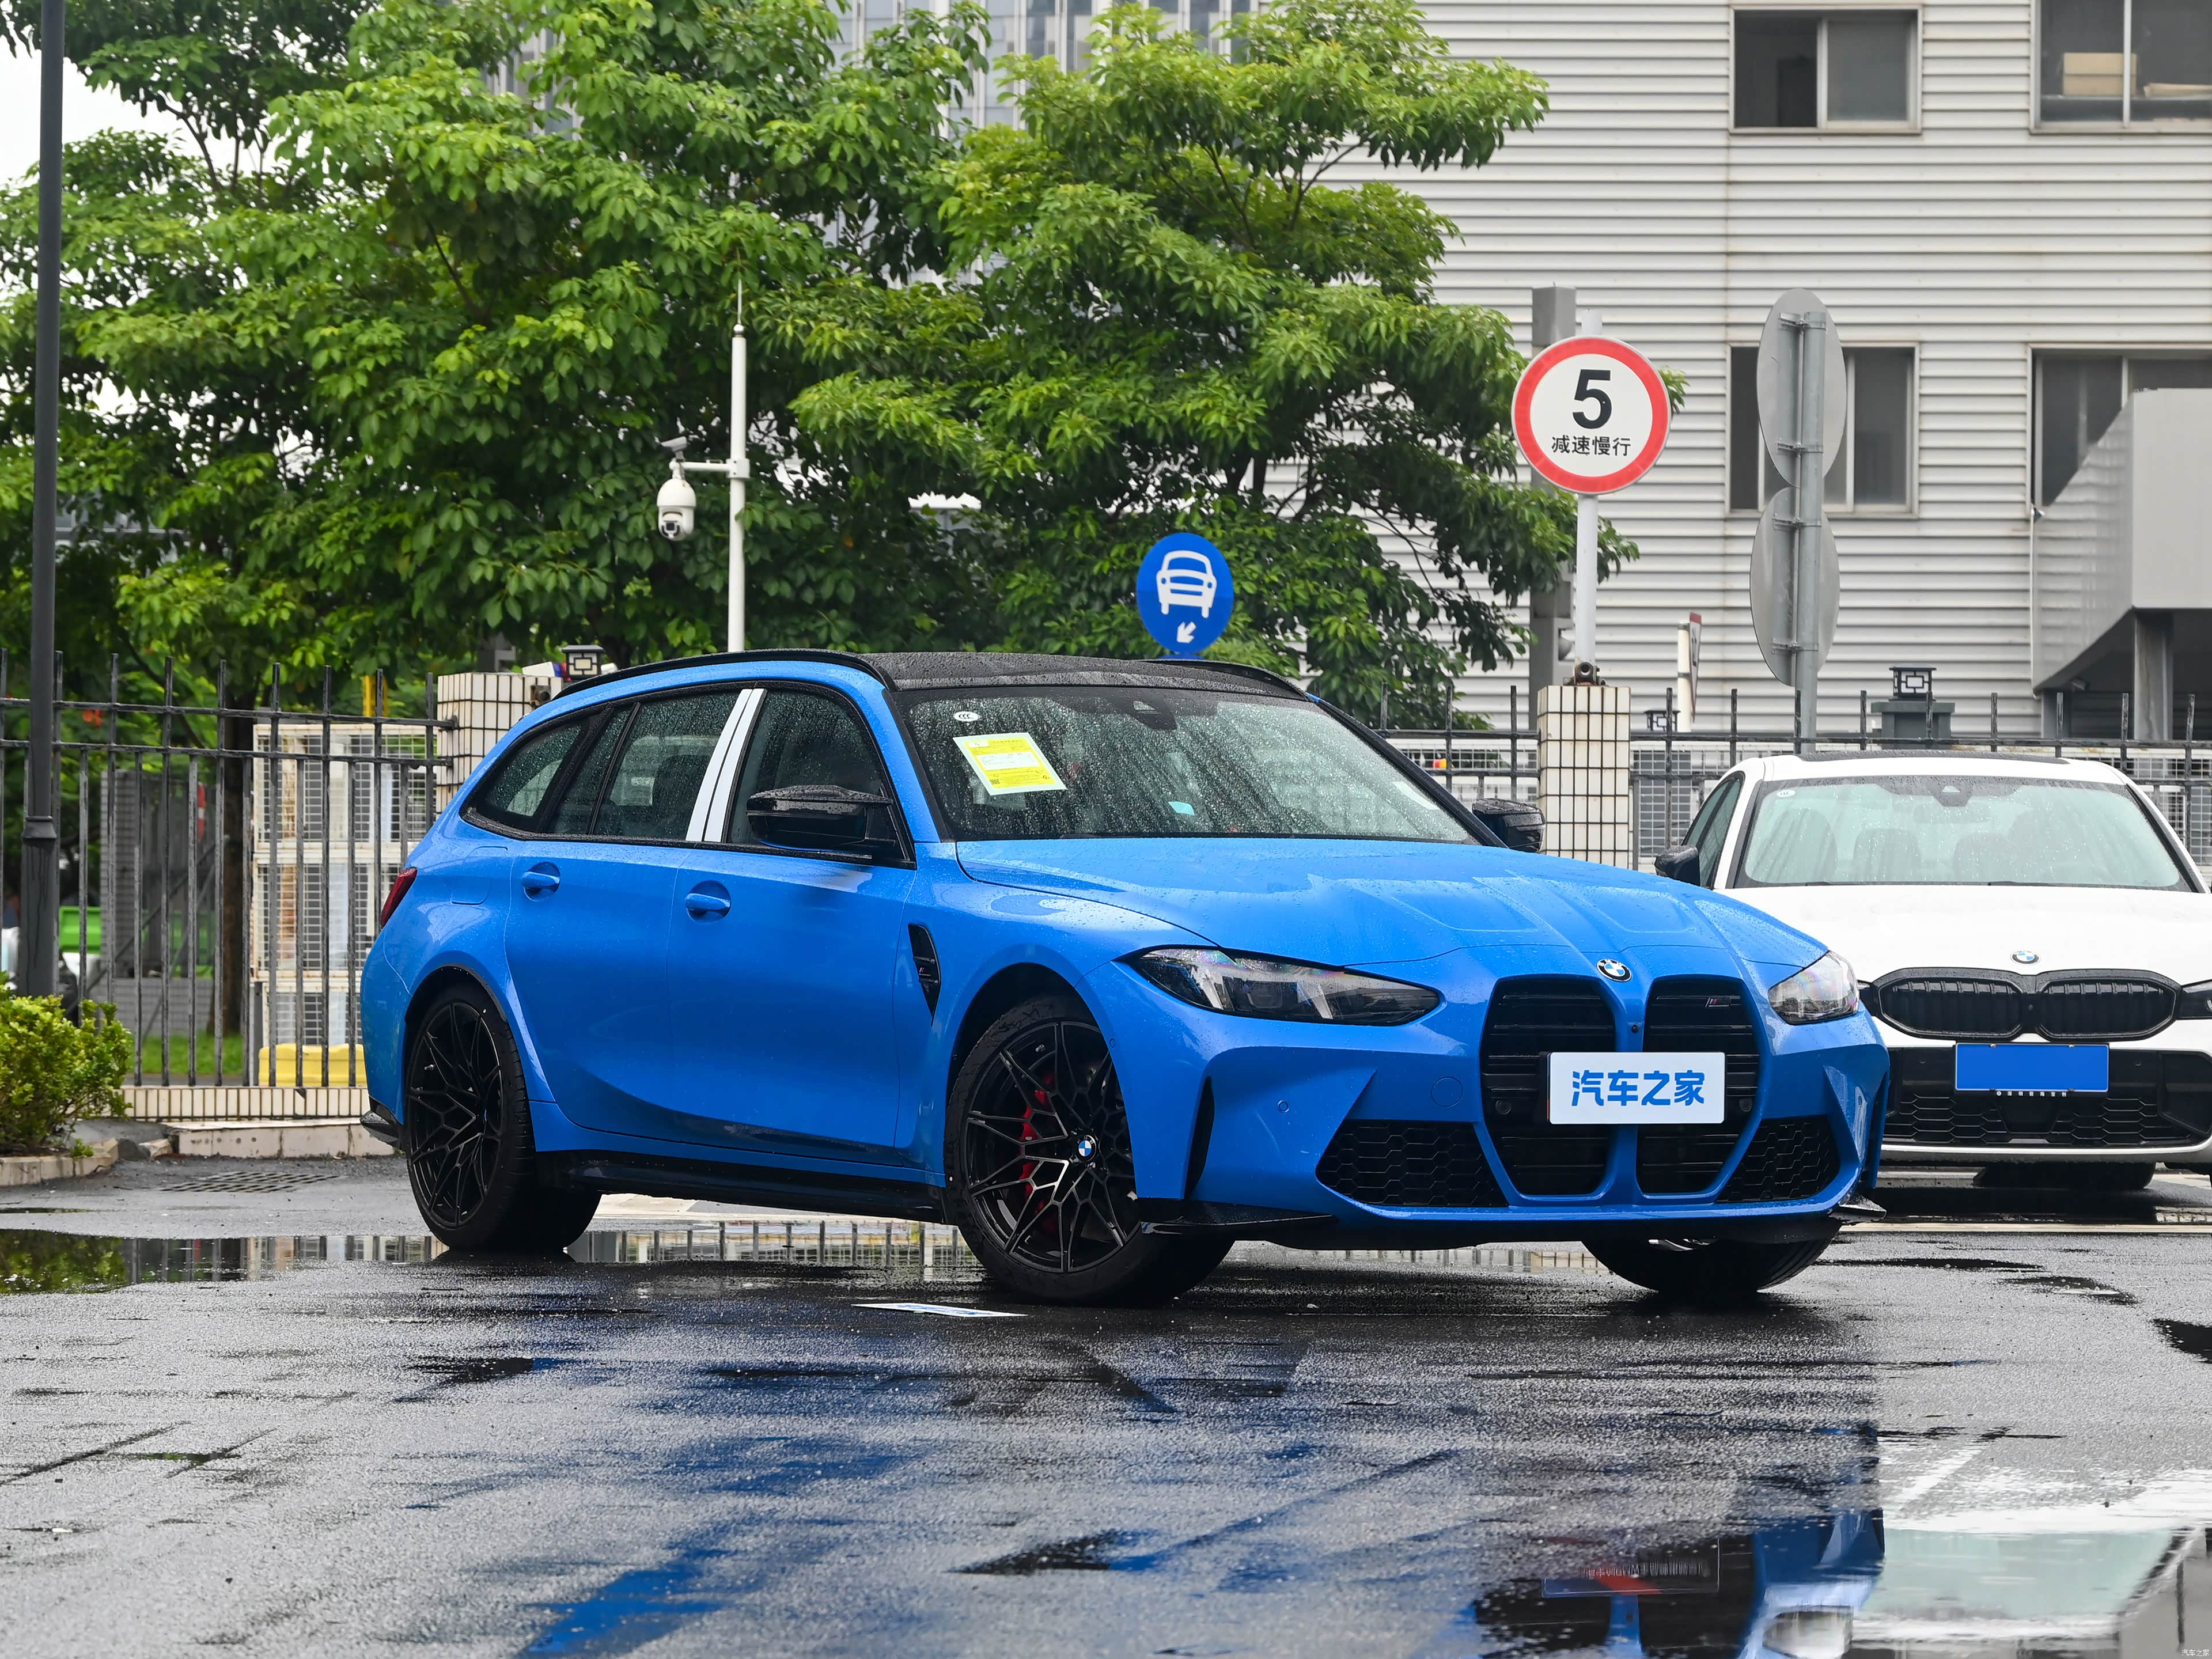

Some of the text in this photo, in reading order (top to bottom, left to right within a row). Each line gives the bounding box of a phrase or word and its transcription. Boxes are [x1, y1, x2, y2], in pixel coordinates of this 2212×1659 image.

[1572, 369, 1612, 429] 5
[1551, 434, 1631, 456] 减速慢行
[1571, 1070, 1705, 1107] 汽车之家
